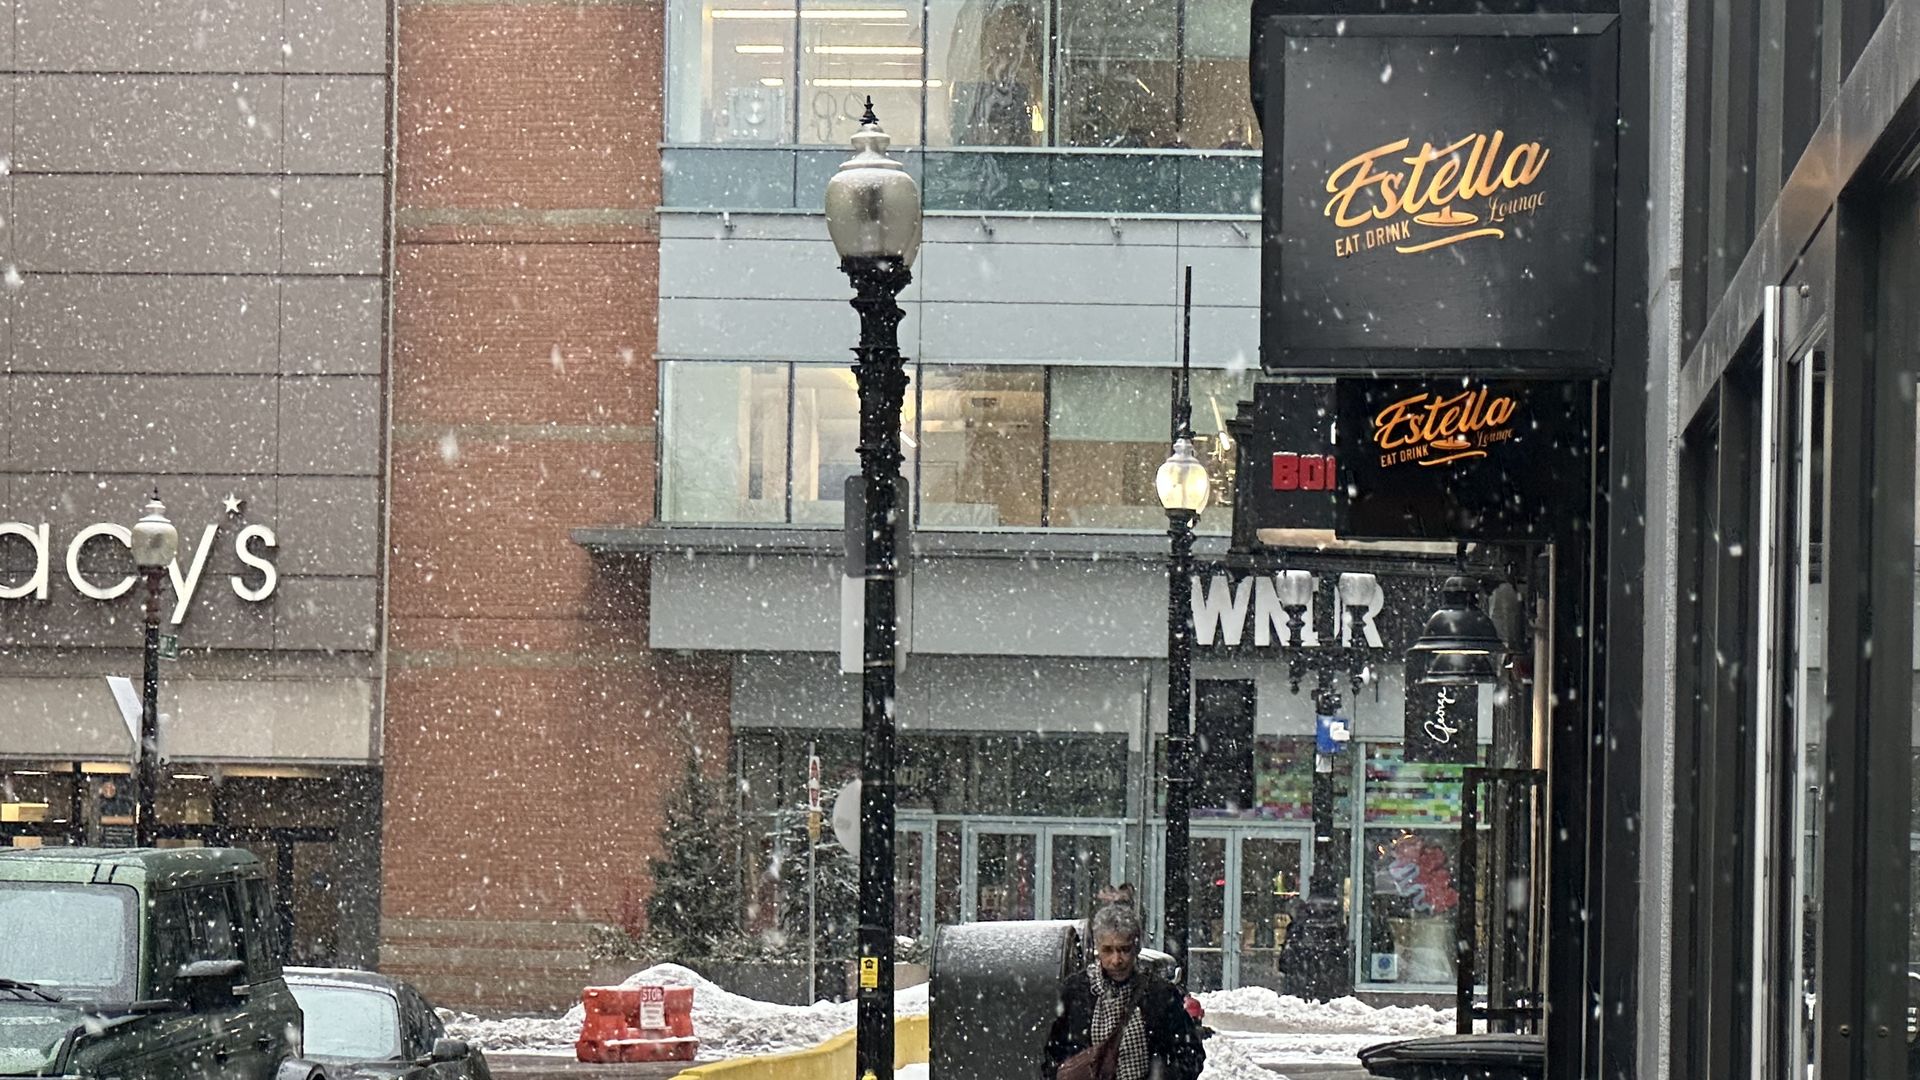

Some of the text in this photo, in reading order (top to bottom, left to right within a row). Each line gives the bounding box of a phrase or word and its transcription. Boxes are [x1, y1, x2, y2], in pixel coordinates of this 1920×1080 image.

[1324, 130, 1549, 228] Estella
[1488, 190, 1546, 223] Lounge
[1335, 220, 1411, 257] EAT DRINK
[1374, 388, 1516, 449] Estella
[1381, 444, 1429, 468] EAT DRINK
[1424, 686, 1458, 743] George
